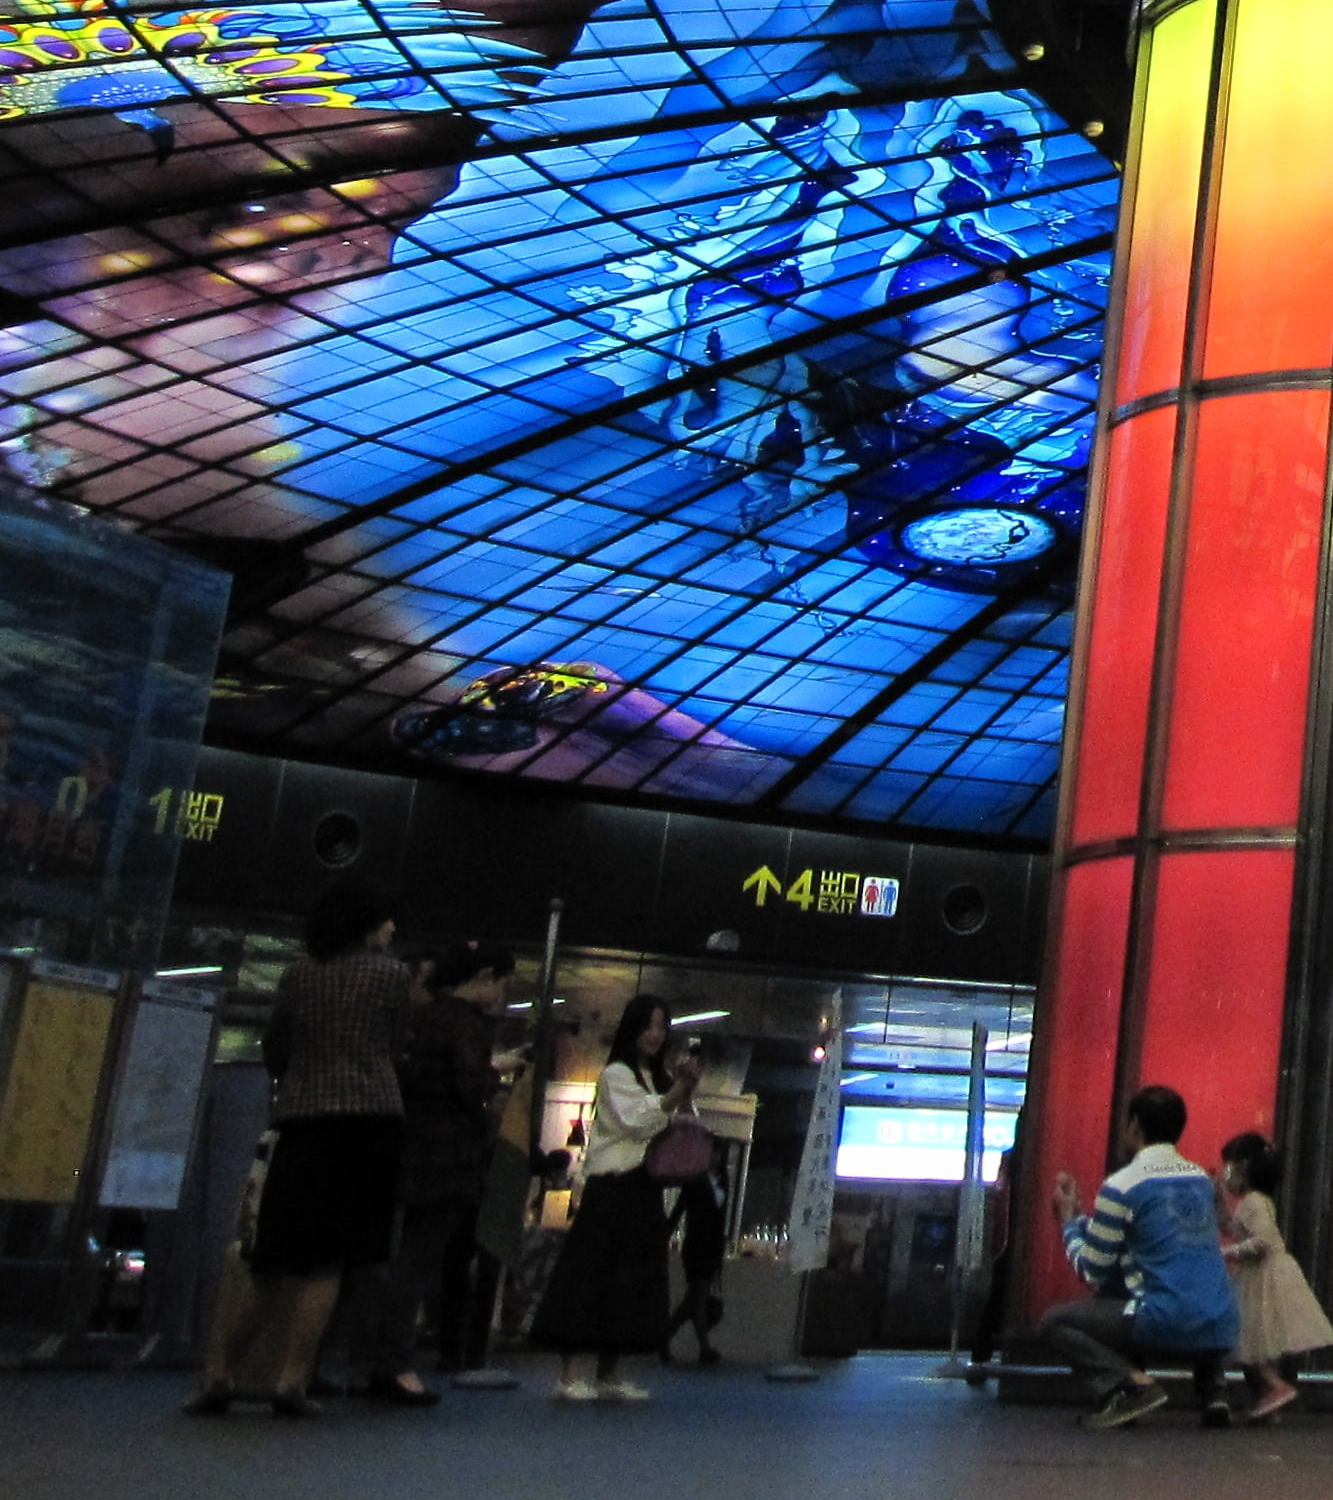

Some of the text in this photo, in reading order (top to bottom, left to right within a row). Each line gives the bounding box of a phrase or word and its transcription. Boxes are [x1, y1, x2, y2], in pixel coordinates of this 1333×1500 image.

[149, 788, 173, 835] 1
[786, 868, 859, 911] 4 出口
[817, 897, 858, 914] EXIT
